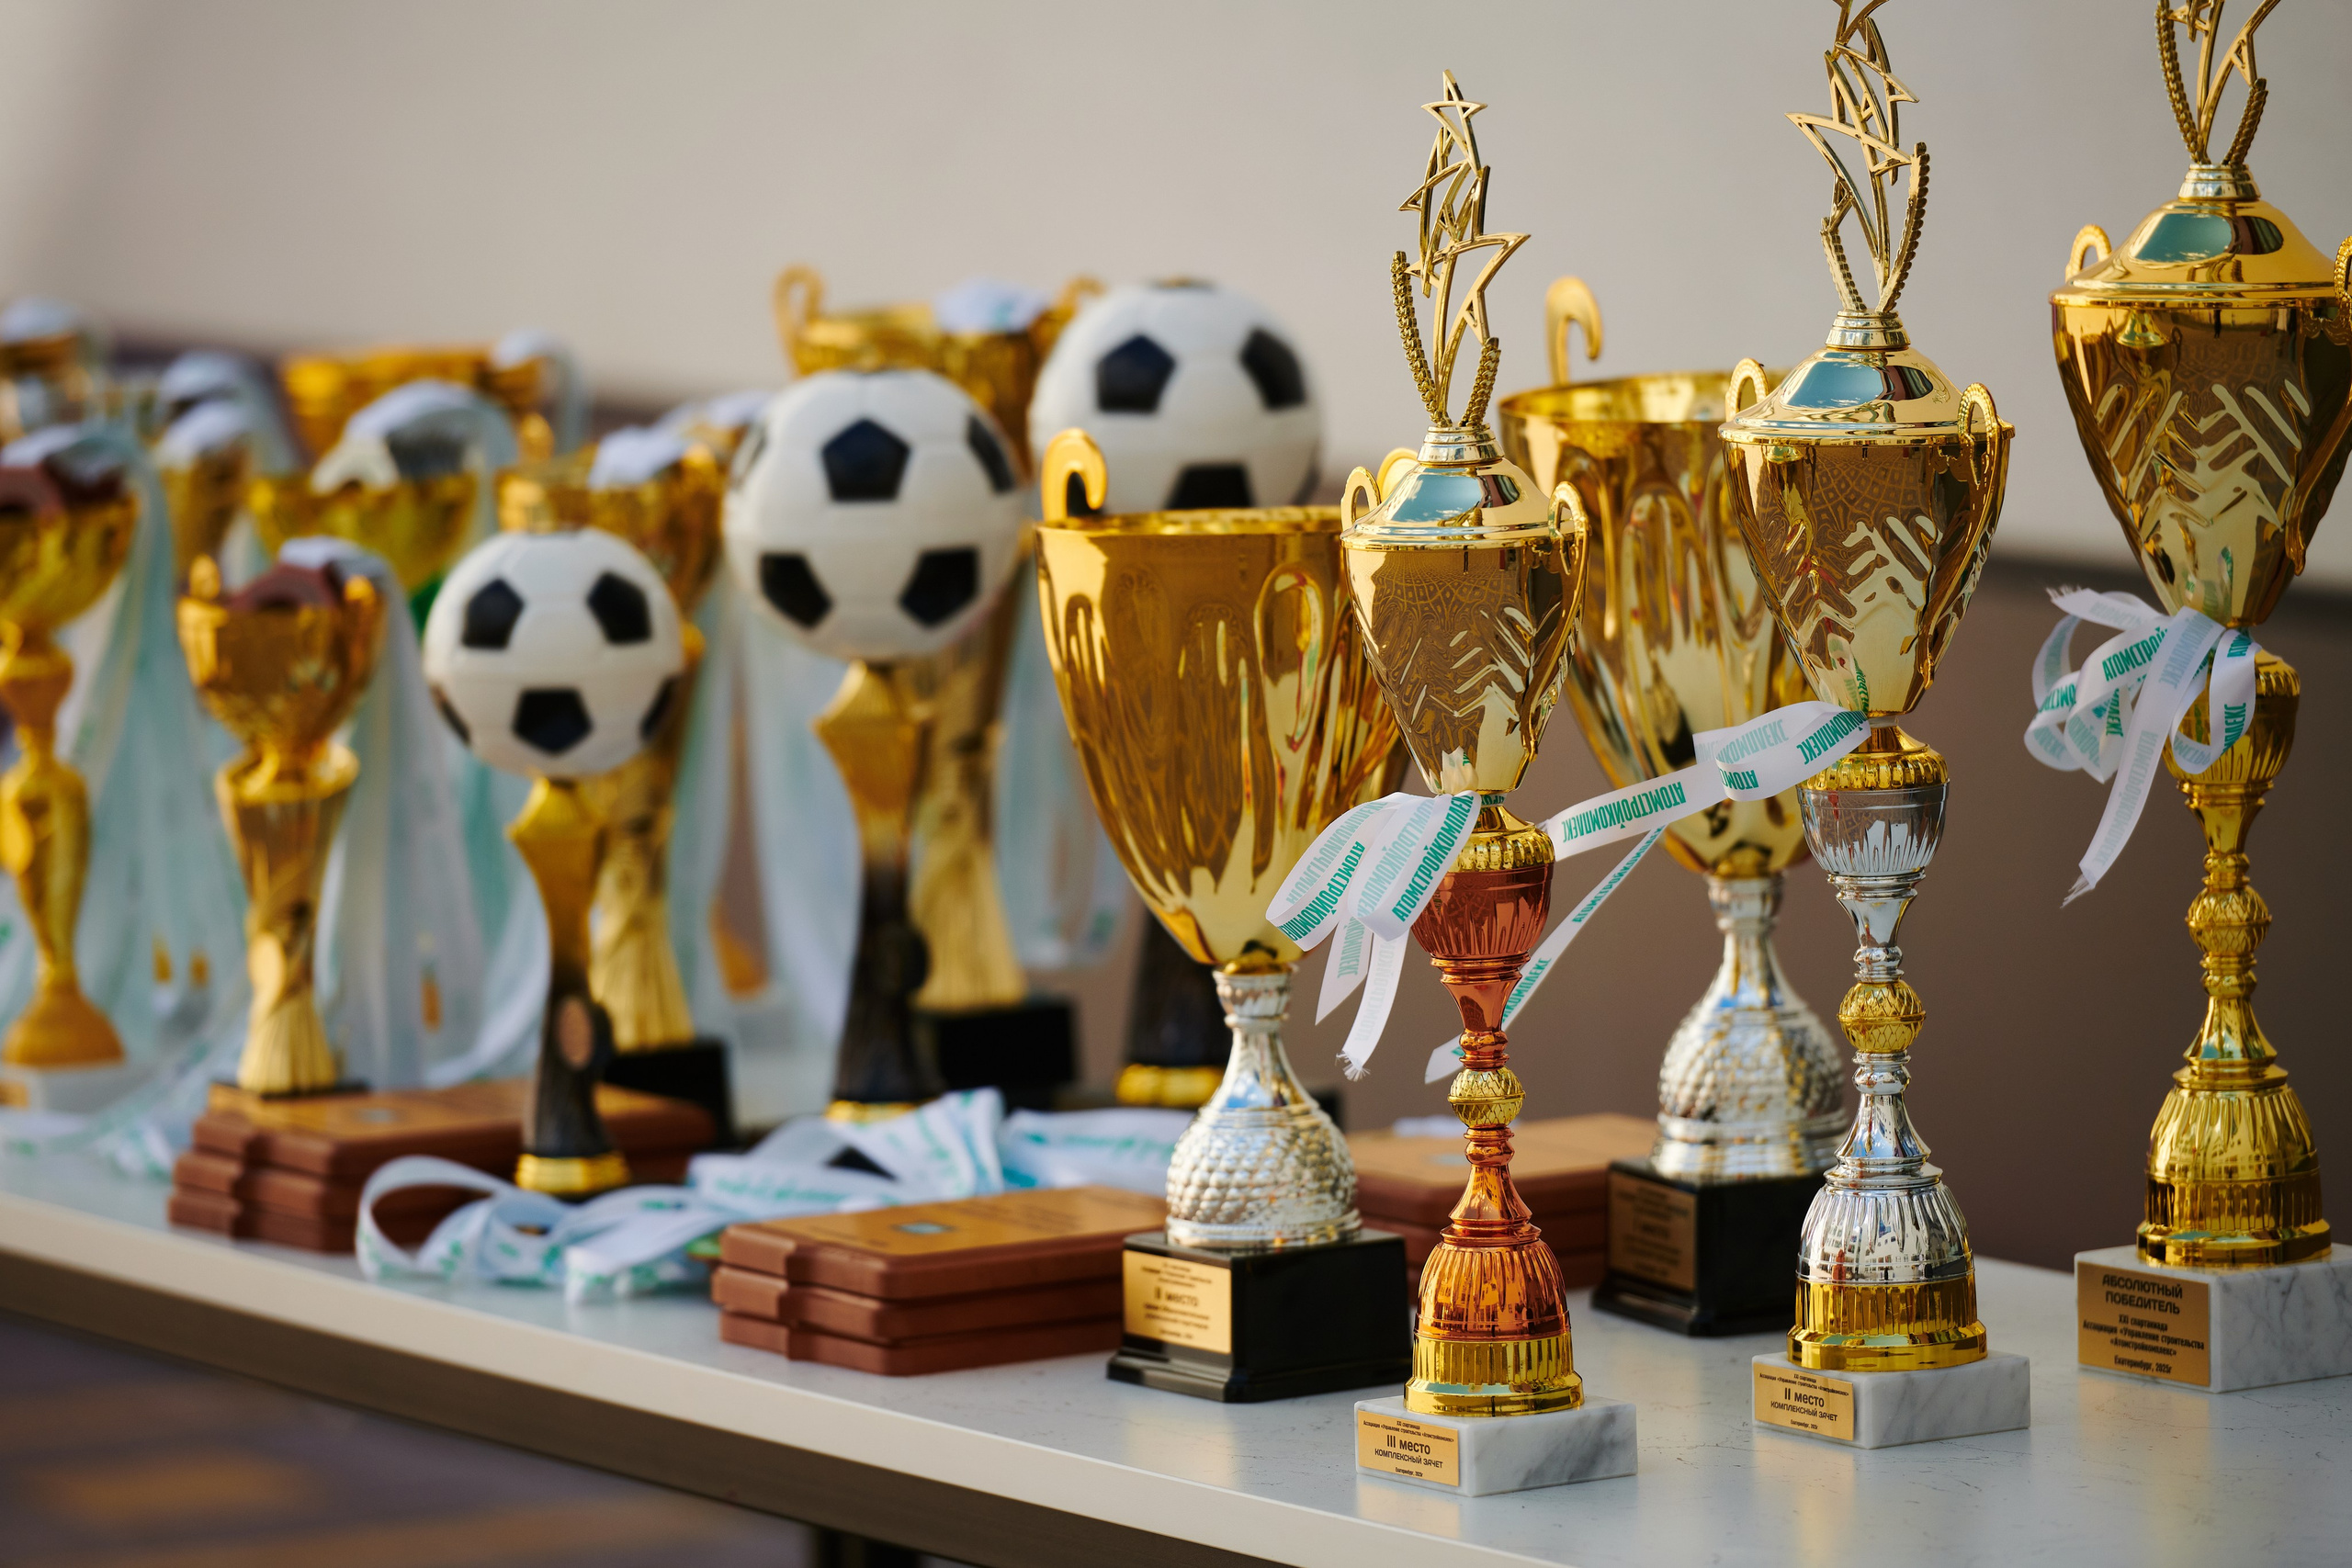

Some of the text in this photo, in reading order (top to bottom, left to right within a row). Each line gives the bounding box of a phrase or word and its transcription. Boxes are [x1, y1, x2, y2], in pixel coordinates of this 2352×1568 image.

[1561, 781, 1687, 843] АТОМСТРОЙКОМПЛЕКС
[2102, 1274, 2183, 1299] АБСОЛЮТНЫЙ
[2106, 1291, 2180, 1314] ПОБЕДИТЕЛЬ
[1784, 1387, 1825, 1407] II место
[1770, 1400, 1838, 1422] КОМПЛЕКСНЫЙ ЗАЧЕТ
[1386, 1434, 1430, 1455] III место
[1374, 1448, 1443, 1469] КОМПЛЕКСНЫЙ ЗАЧЕТ
